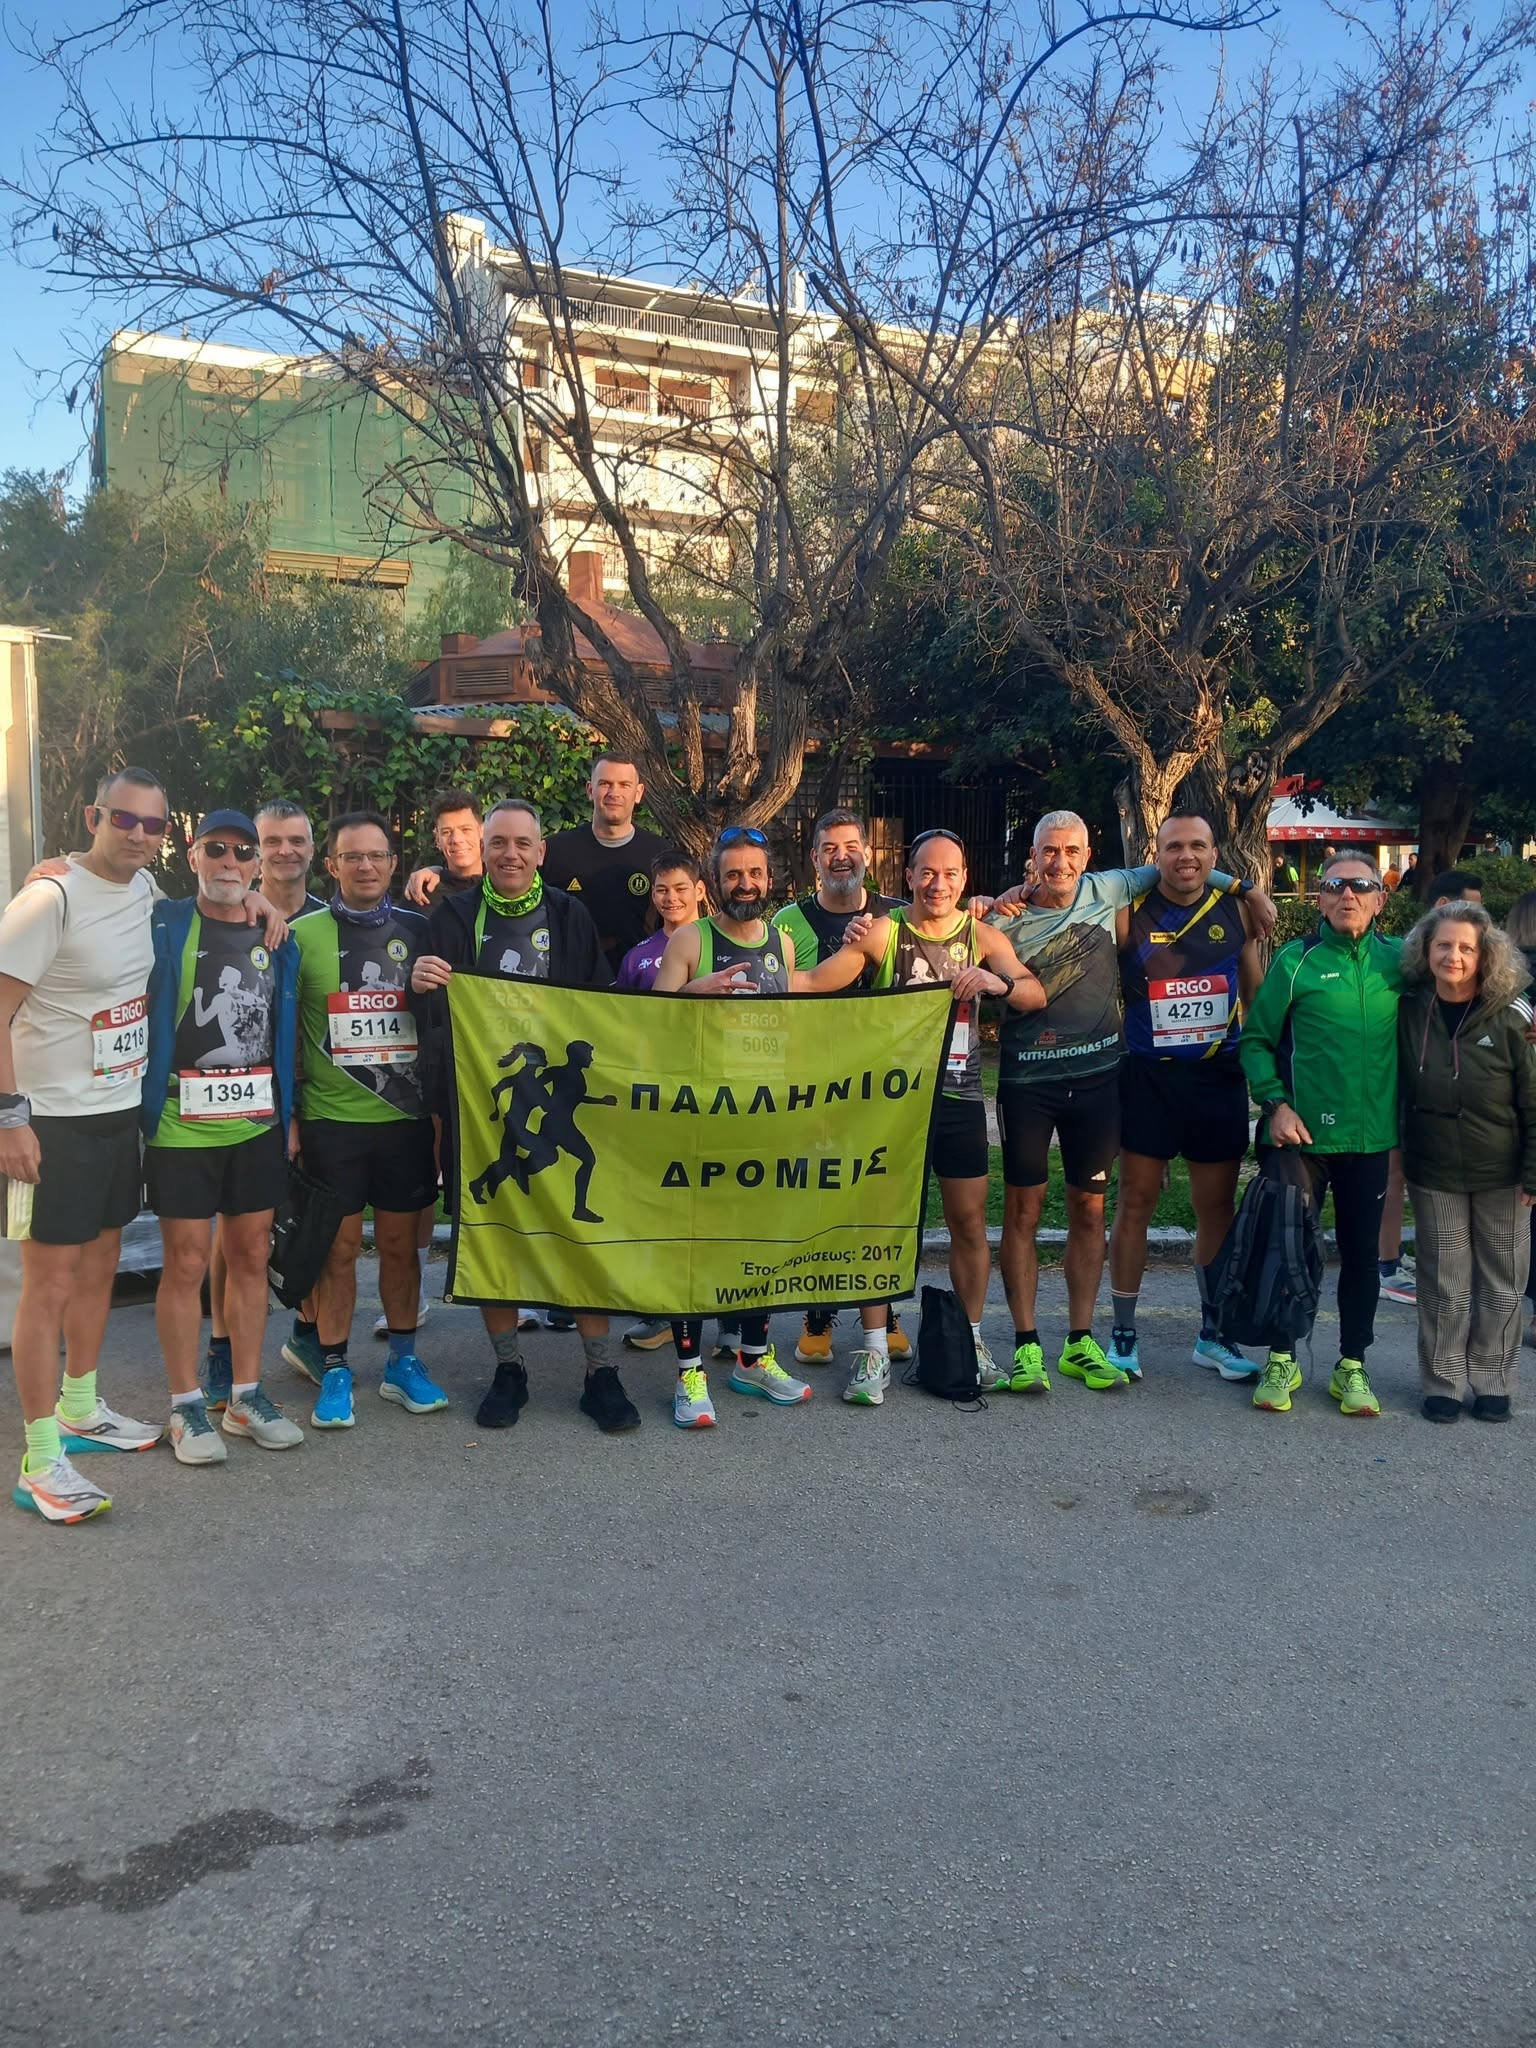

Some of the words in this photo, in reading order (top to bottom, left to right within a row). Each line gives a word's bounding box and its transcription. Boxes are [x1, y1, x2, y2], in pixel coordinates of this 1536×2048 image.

[1166, 979, 1212, 996] ERGO
[348, 994, 398, 1010] ERGO
[1168, 1001, 1214, 1019] 4279
[110, 1000, 143, 1025] ERGO
[741, 1013, 779, 1028] ERGO
[351, 1017, 401, 1037] 5114
[113, 1027, 144, 1054] 4218
[742, 1036, 778, 1054] 5069
[1018, 1041, 1102, 1061] KITHAIRONAS
[203, 1082, 255, 1102] 1394
[660, 1146, 887, 1190] ΔΡΟΜΕΙΣ
[861, 1245, 903, 1261] 2017
[715, 1273, 901, 1305] WWW.DROMEIS.GR
